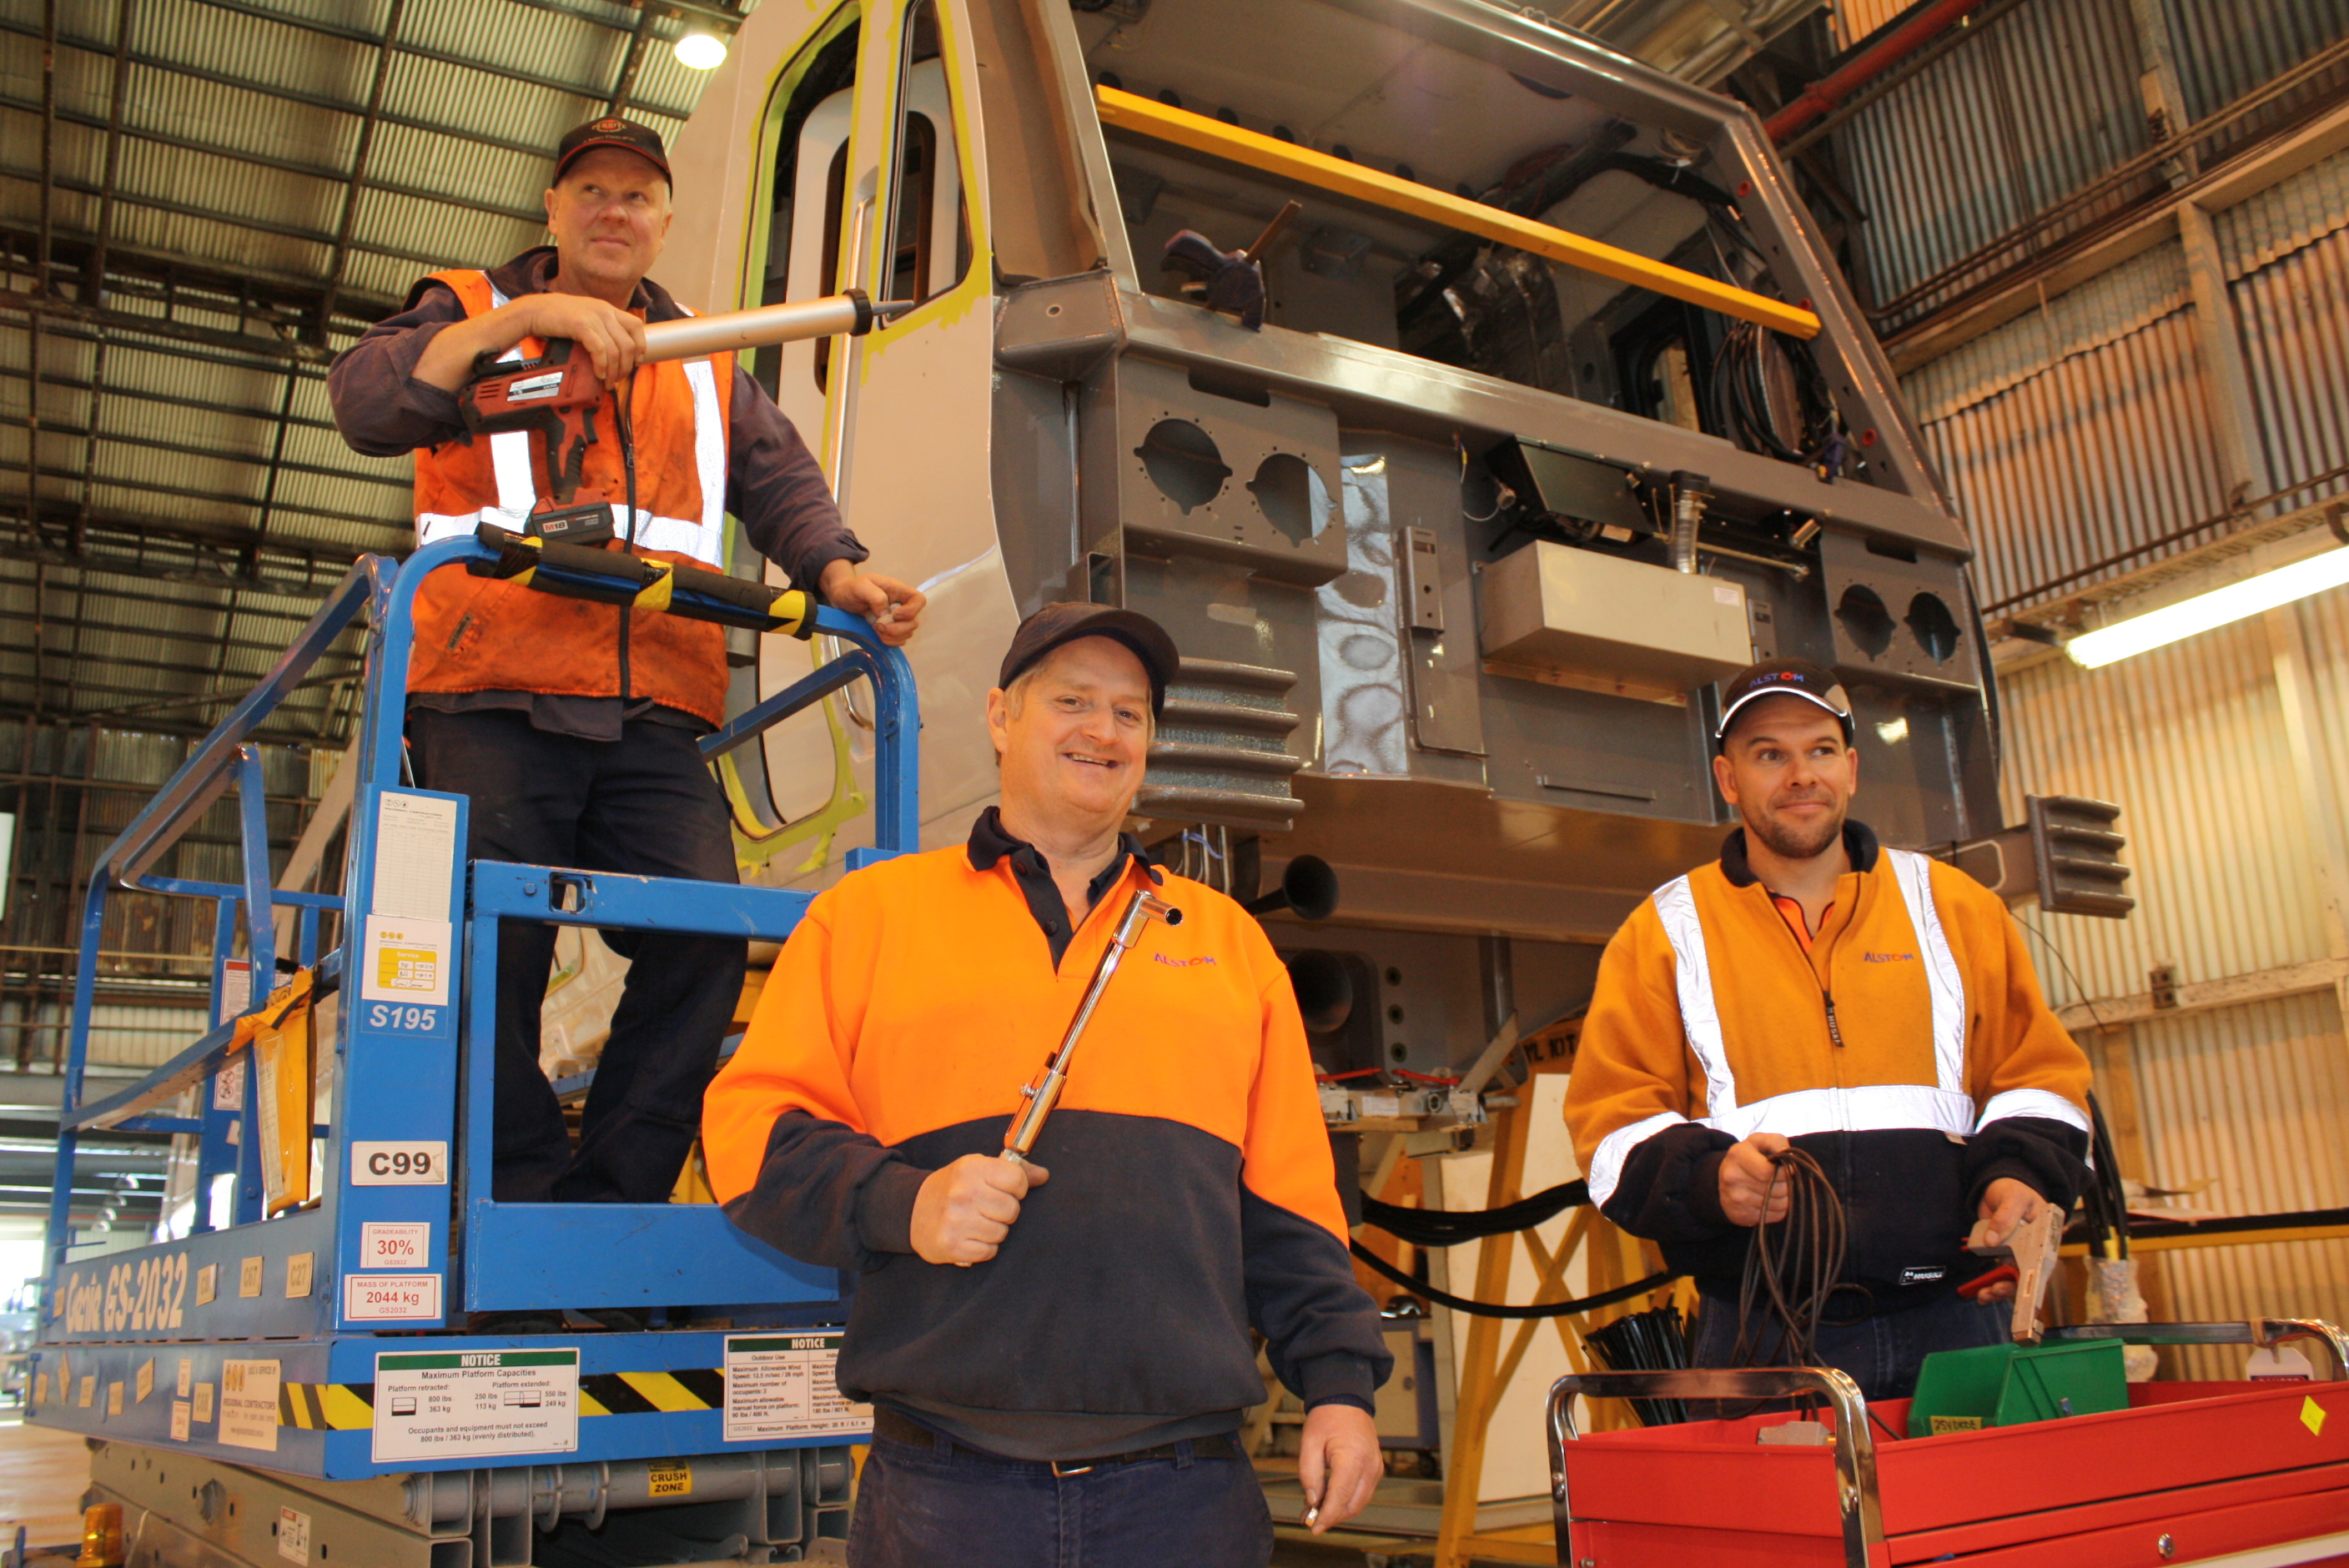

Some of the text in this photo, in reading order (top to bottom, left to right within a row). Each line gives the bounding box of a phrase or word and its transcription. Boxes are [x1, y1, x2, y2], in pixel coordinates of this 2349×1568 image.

[545, 521, 566, 531] M18
[1748, 671, 1804, 689] ALSTOM
[1154, 952, 1216, 967] ALSTOM
[1864, 952, 1914, 963] ALSTOM
[370, 1004, 436, 1031] S195
[369, 1152, 431, 1176] C99
[377, 1239, 414, 1255] 30%
[292, 1263, 307, 1287] C27
[66, 1272, 103, 1334] Genie
[103, 1251, 189, 1332] GS-2032
[366, 1291, 420, 1305] 2044 kg
[792, 1338, 825, 1349] NOTICE
[460, 1354, 501, 1367] NOTICE
[421, 1369, 536, 1380] Maximum Platform Capacities
[244, 1400, 276, 1410] CONTRACTORS
[408, 1425, 445, 1435] Occupants
[460, 1423, 494, 1433] equipment
[525, 1420, 548, 1429] exceed
[462, 1434, 470, 1442] kg
[472, 1432, 495, 1442] (evenly
[497, 1430, 536, 1440] distributed).
[651, 1471, 687, 1482] CRUSH
[654, 1482, 684, 1493] ZONE
